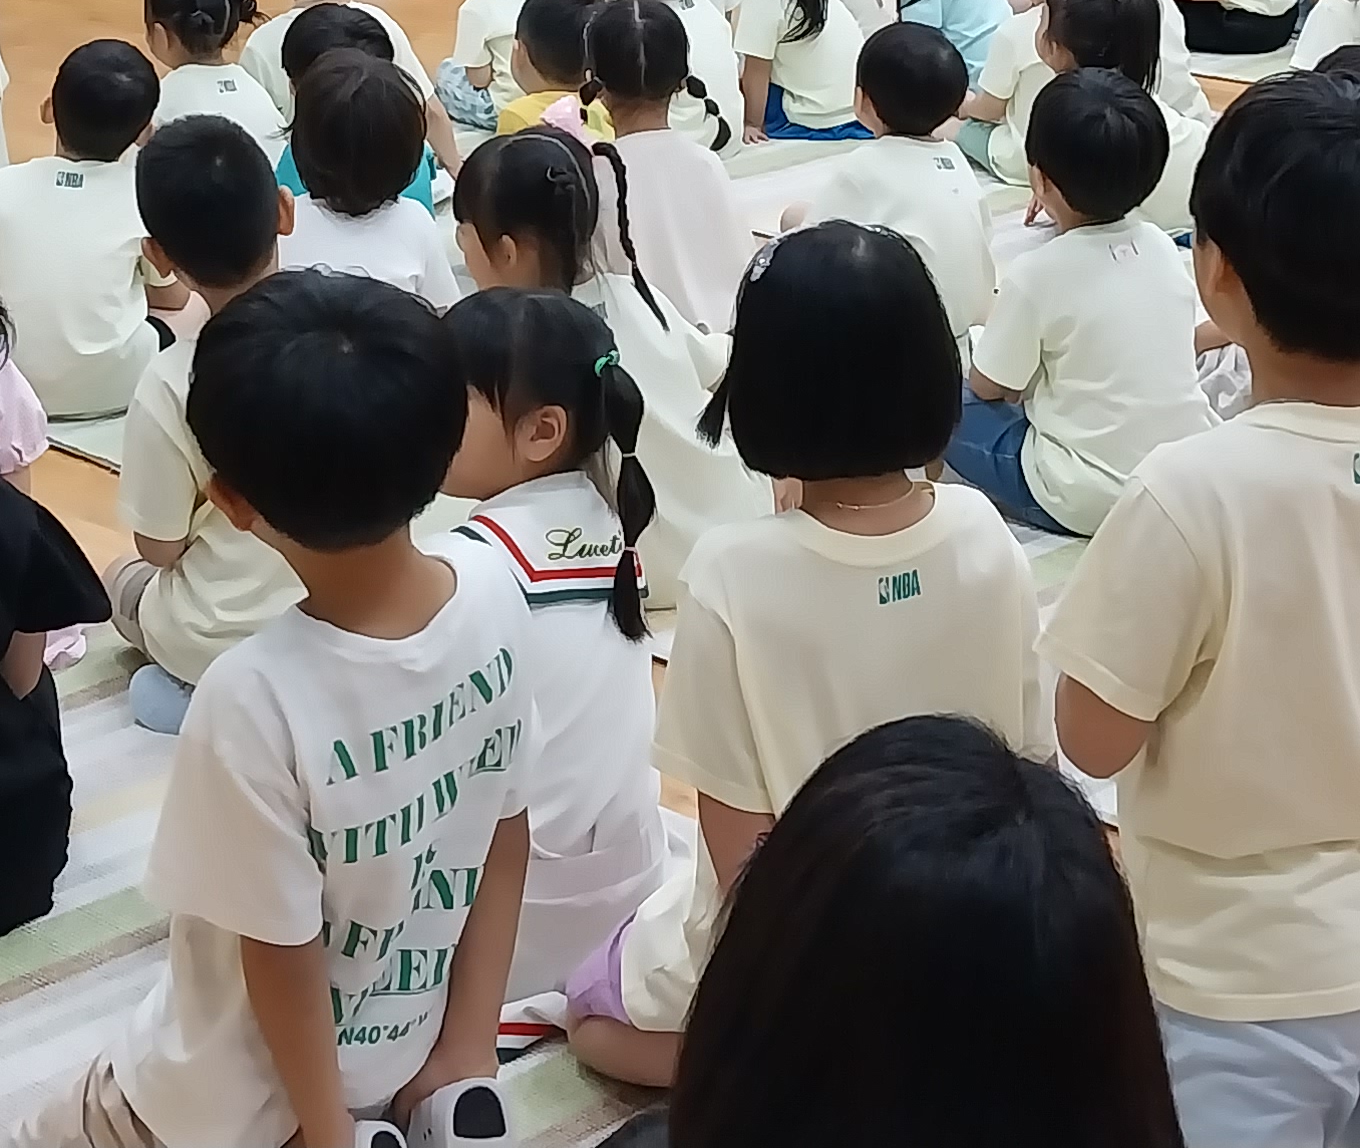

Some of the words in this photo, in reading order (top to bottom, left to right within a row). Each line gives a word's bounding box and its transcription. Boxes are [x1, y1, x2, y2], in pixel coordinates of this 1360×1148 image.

[891, 569, 921, 602] NBA
[326, 737, 360, 786] A
[370, 647, 514, 773] FRIEND
